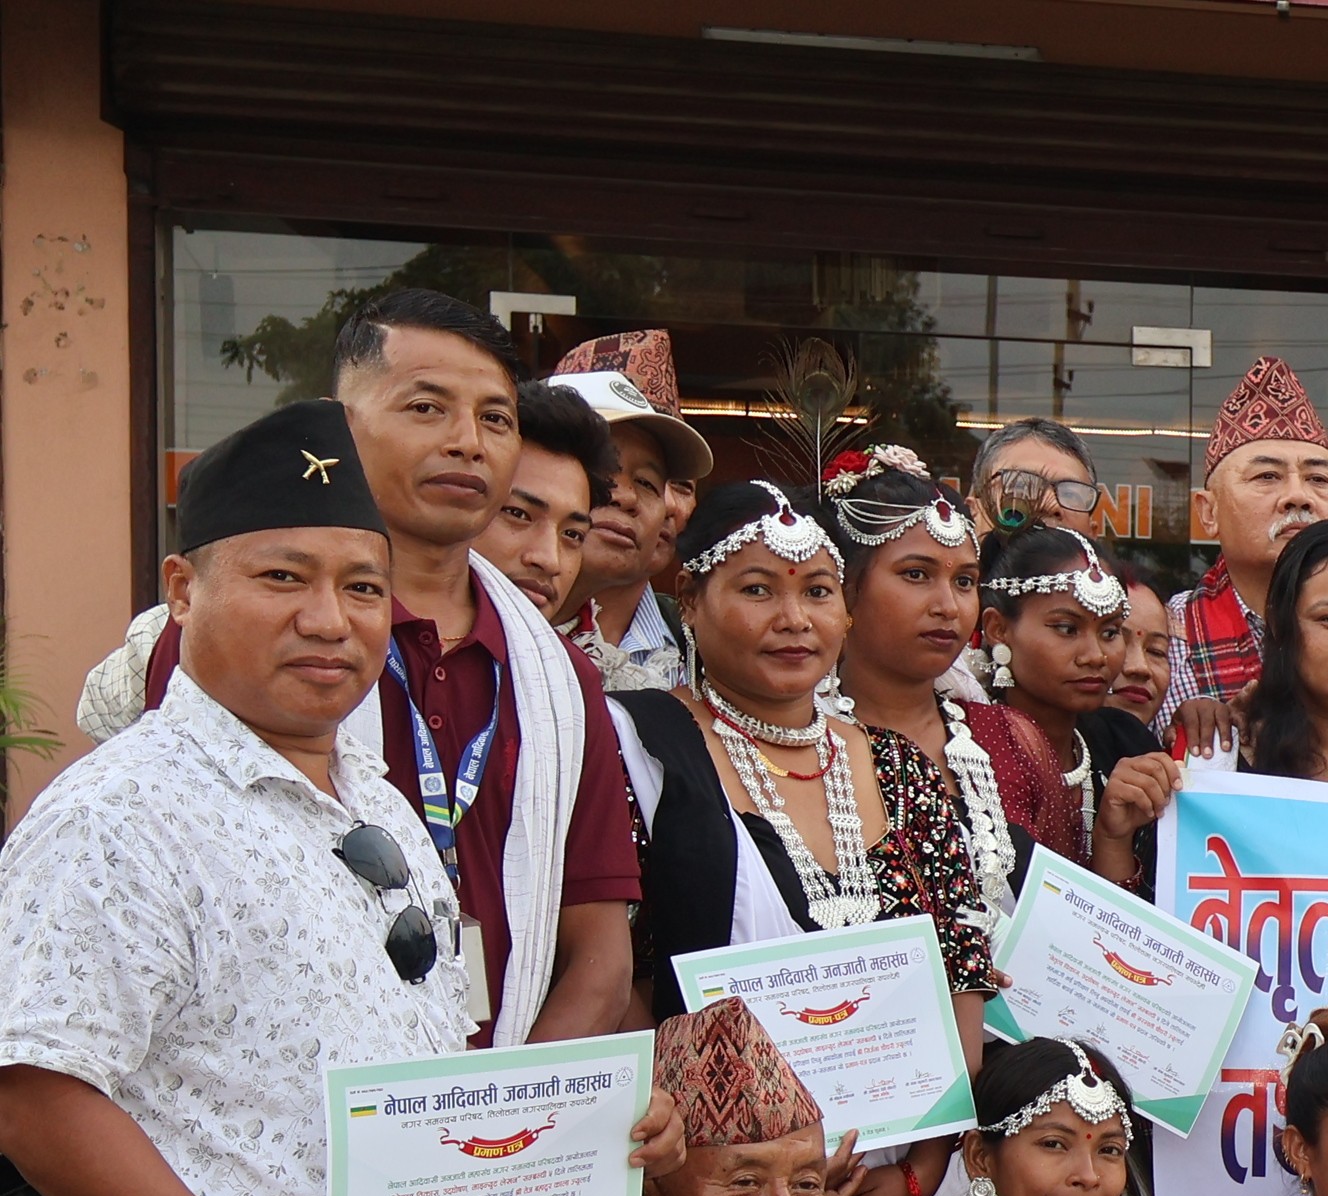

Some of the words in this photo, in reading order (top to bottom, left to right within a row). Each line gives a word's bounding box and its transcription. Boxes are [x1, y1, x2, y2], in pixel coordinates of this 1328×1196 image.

[1064, 888, 1096, 916] नेपाल
[727, 976, 764, 995] नेपाल
[765, 963, 819, 989] आदिवासी
[868, 951, 909, 971] महासंघ
[383, 1094, 428, 1116] नेपाल
[431, 1082, 499, 1112] आदिवासी
[564, 1070, 613, 1095] महासंघ
[474, 1140, 523, 1157] प्रमाण-पत्र
